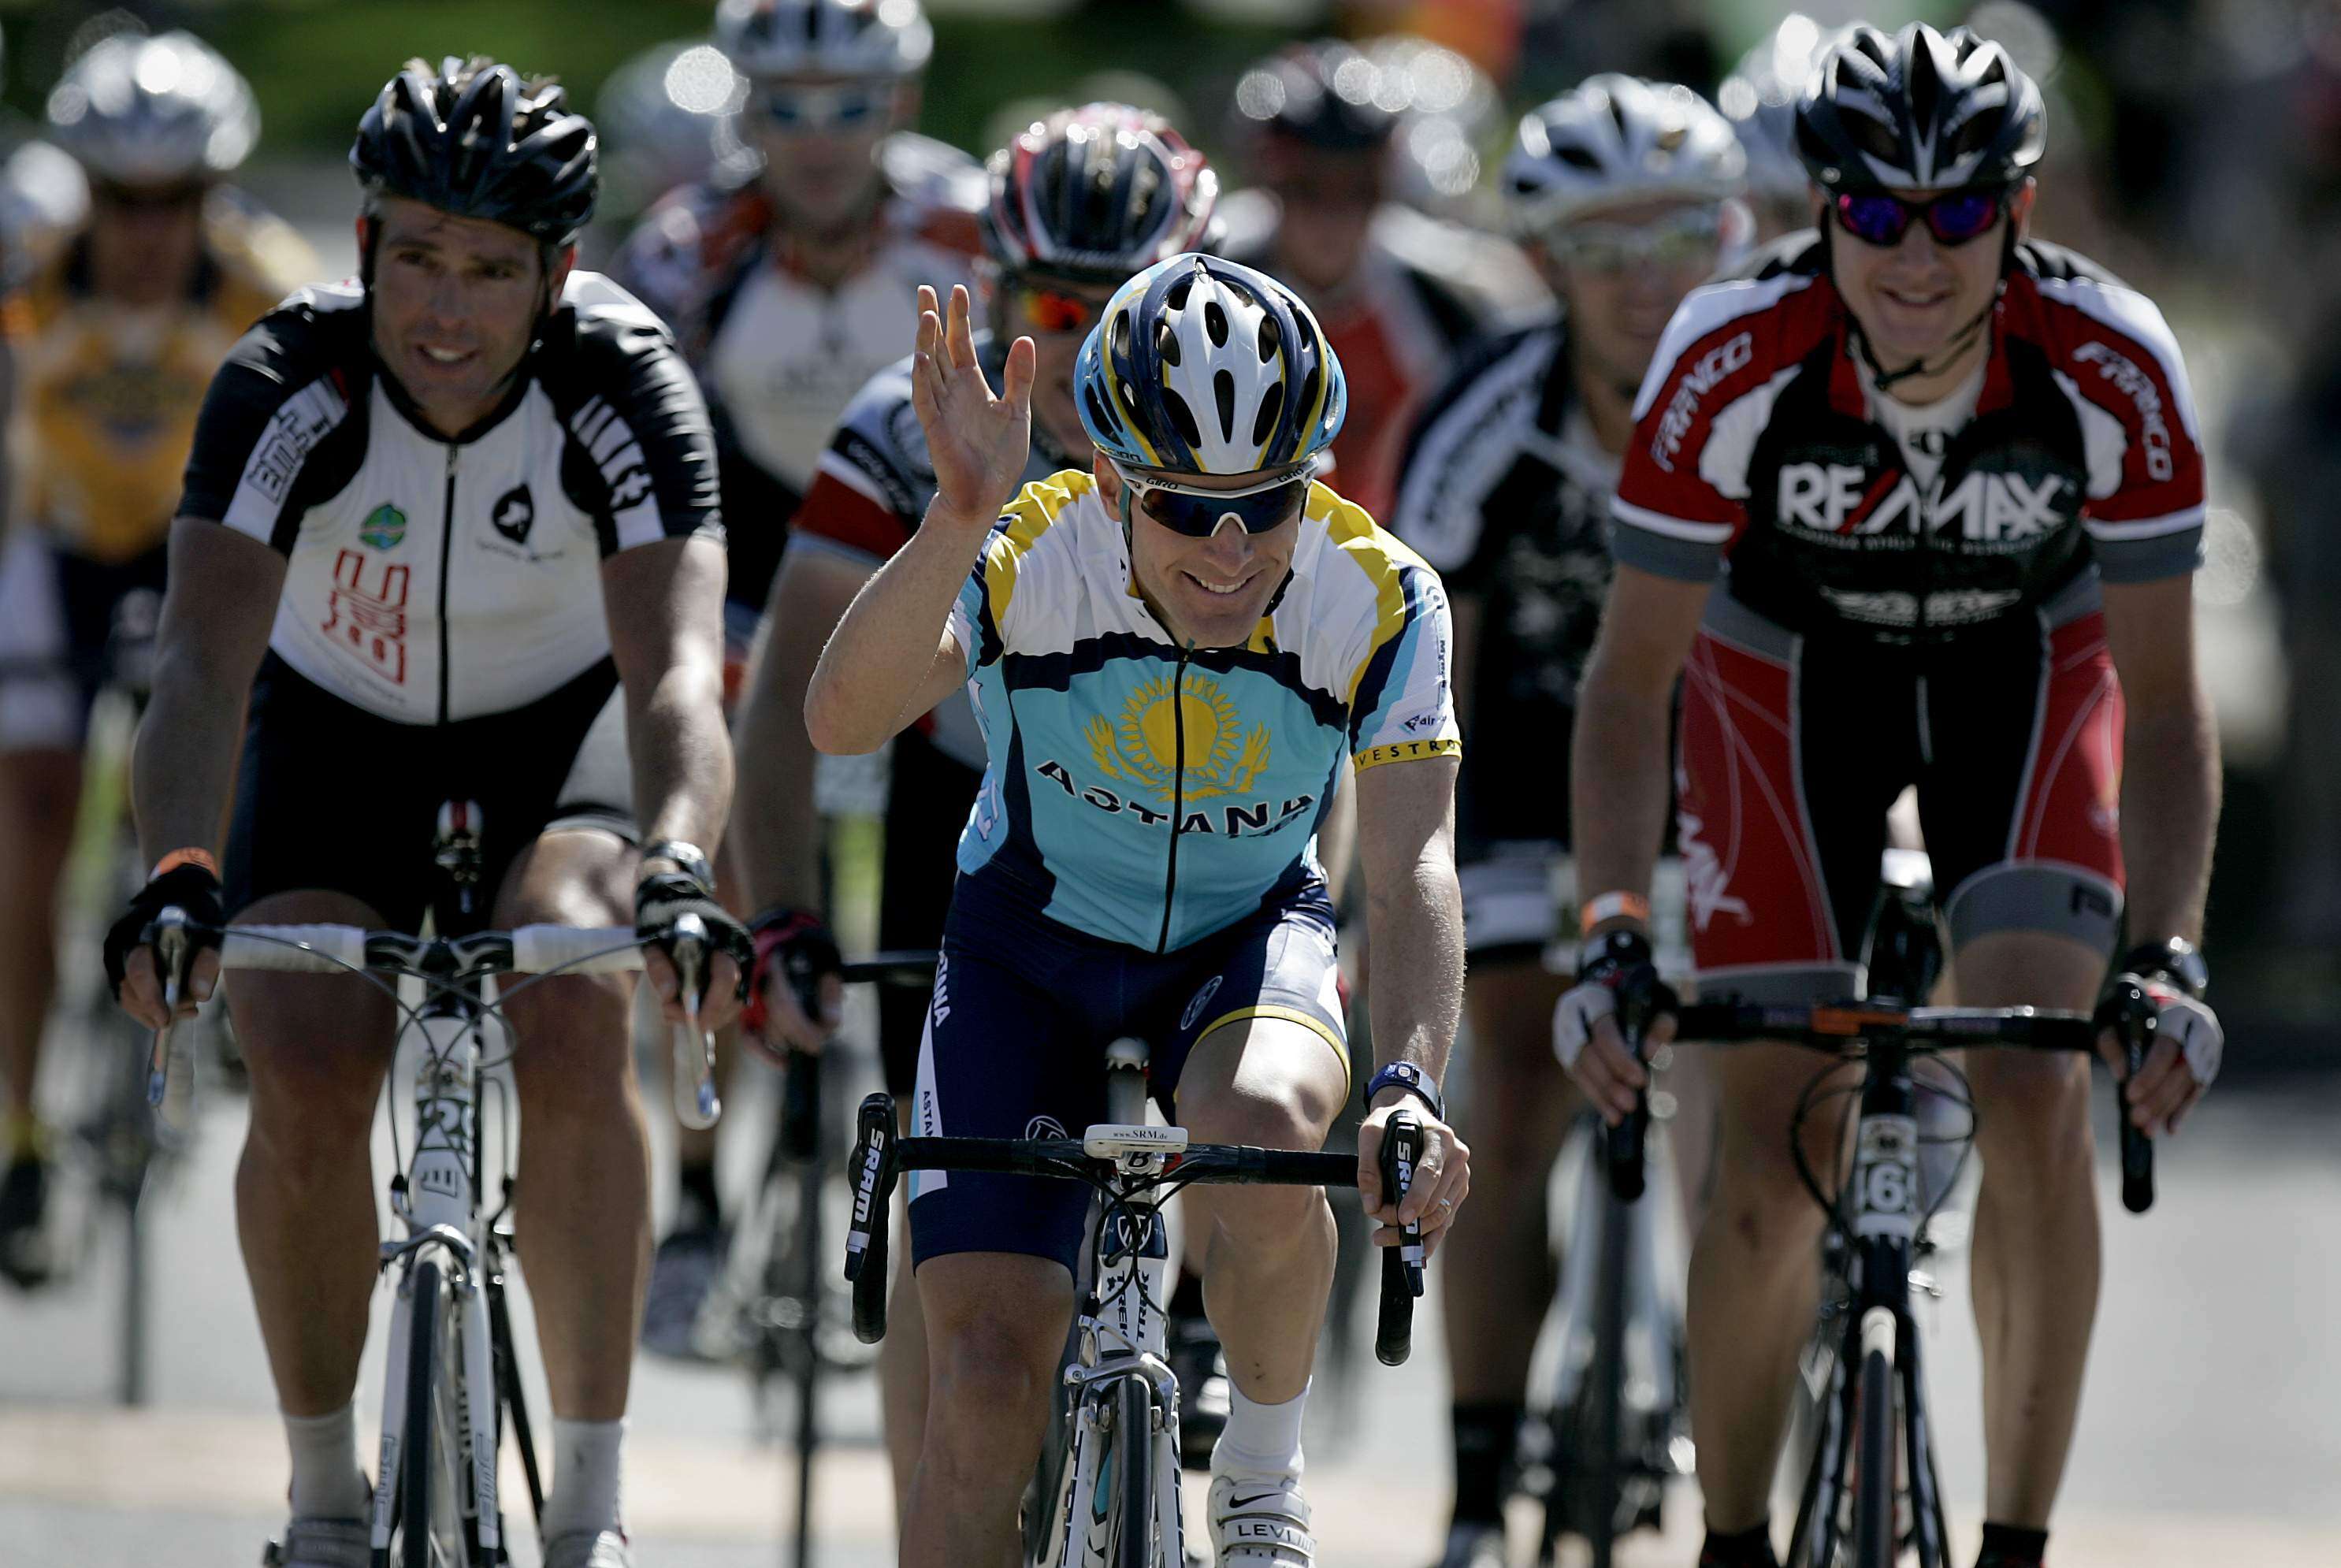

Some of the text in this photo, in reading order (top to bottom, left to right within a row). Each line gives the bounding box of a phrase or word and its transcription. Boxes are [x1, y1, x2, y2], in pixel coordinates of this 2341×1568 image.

[1651, 332, 1752, 473] FRANCO
[2072, 340, 2173, 481] FRANCO
[1146, 477, 1179, 490] GIRO
[1277, 469, 1304, 482] GIRO
[1034, 760, 1315, 835] ASTANA
[1113, 1130, 1167, 1139] www.SRM.de
[855, 1128, 885, 1223] SRAM
[1238, 1524, 1291, 1542] LEVI
